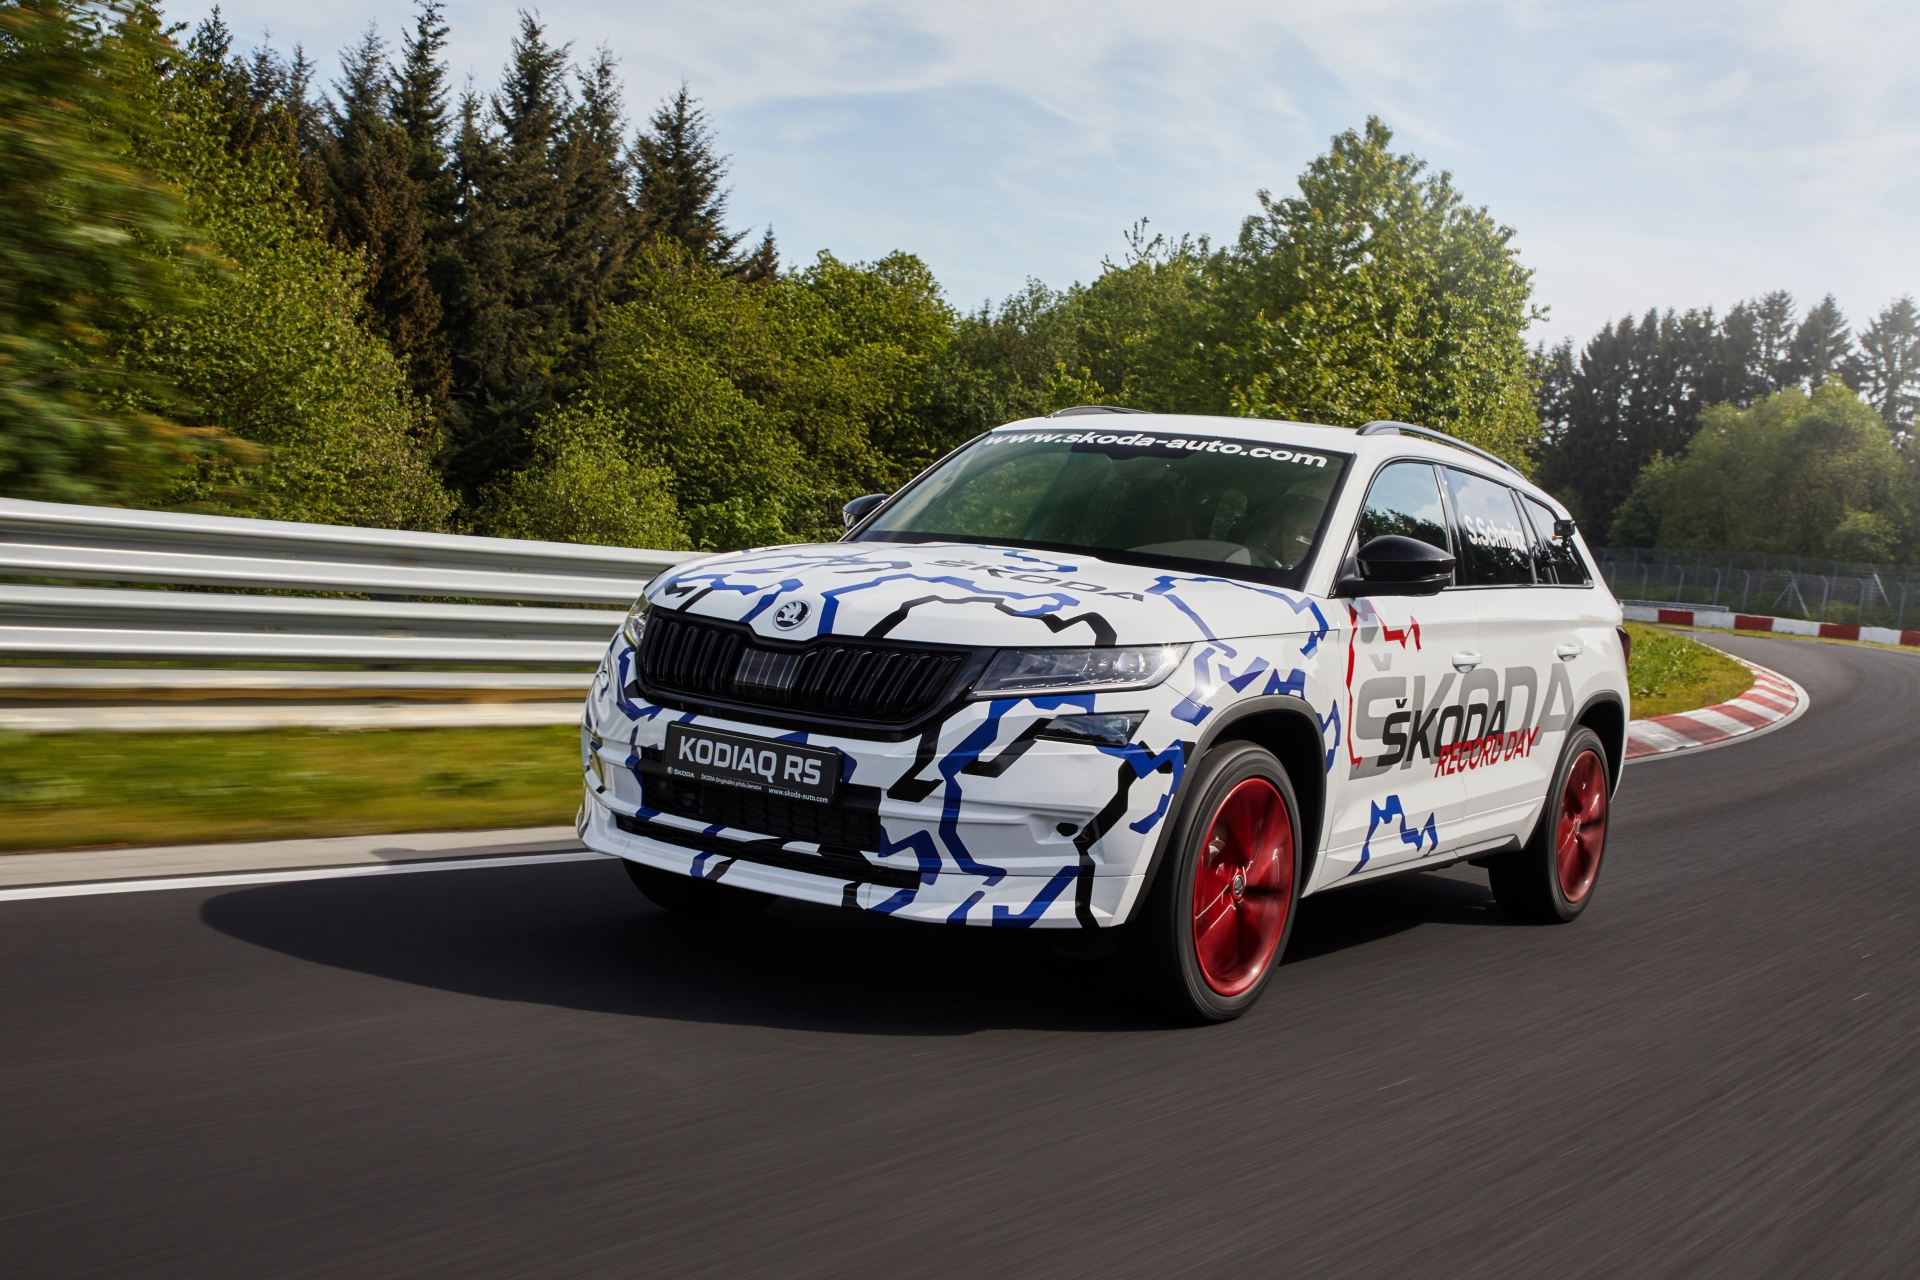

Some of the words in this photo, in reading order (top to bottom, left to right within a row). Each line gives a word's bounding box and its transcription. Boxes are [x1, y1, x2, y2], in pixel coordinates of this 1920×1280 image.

[984, 431, 1327, 468] www.skoda-auto.com
[1464, 514, 1527, 550] S.Schmitz
[925, 559, 1144, 601] ŠKODA
[1349, 653, 1574, 781] ŠKODA
[1377, 699, 1506, 767] ŠKODA
[679, 736, 775, 783] KODIAQ
[784, 755, 822, 785] RS
[1434, 734, 1503, 778] RECORD
[1504, 727, 1539, 762] DAY
[768, 787, 829, 803] www.skoda-auto.com
